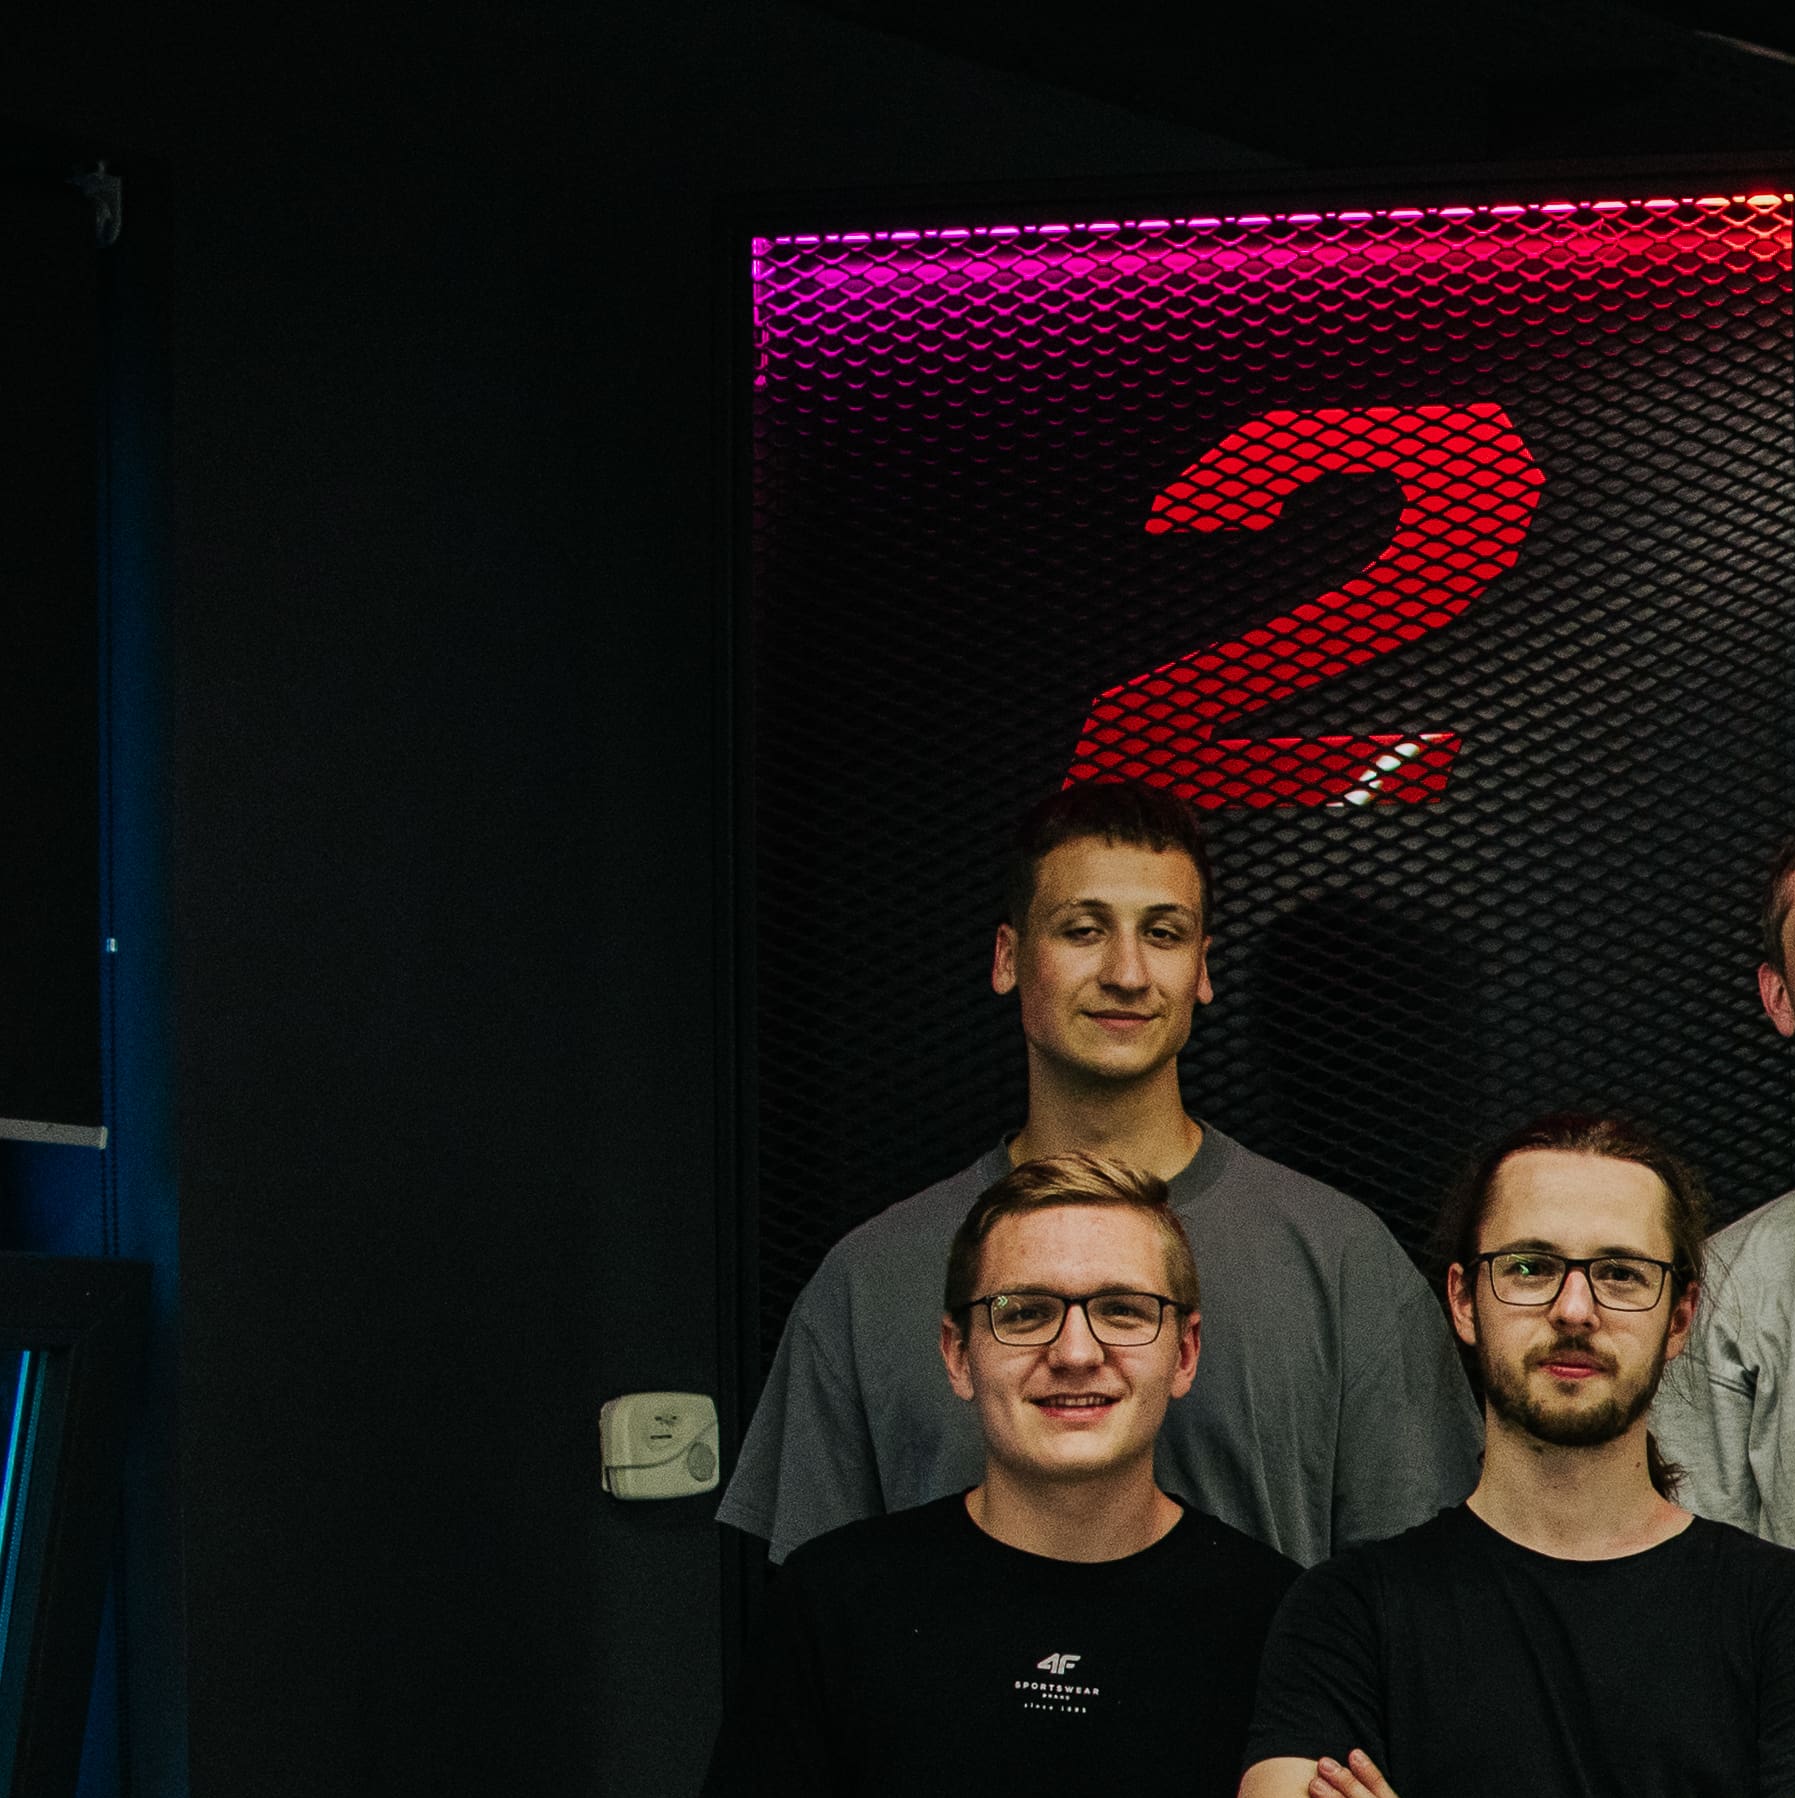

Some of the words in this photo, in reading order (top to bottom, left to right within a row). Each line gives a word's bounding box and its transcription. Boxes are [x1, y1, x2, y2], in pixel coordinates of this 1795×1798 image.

[1062, 401, 1547, 809] 2
[1037, 1652, 1081, 1675] 4F
[1014, 1680, 1100, 1696] SPORTSWEAR
